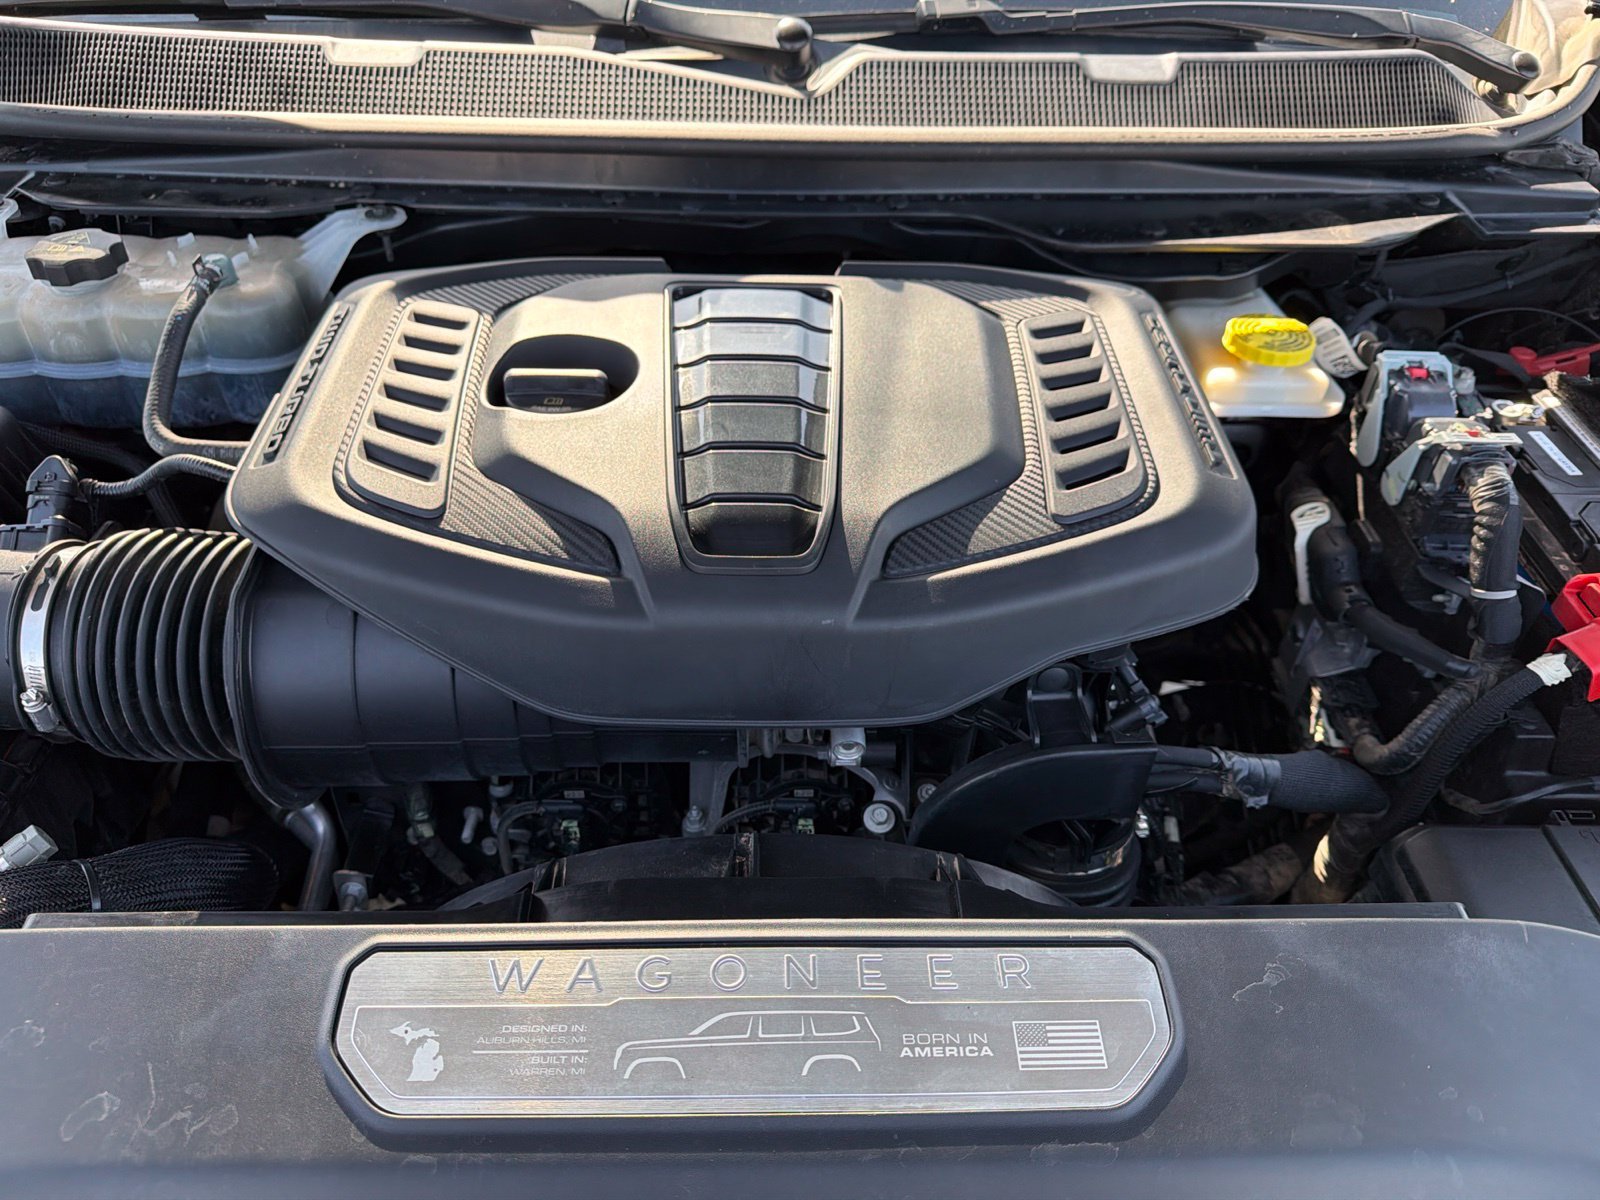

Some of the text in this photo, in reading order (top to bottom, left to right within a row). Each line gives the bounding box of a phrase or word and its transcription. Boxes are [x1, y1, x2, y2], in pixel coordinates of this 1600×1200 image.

[266, 305, 351, 452] TWIN TURBO
[488, 953, 1032, 993] WAGONEER
[501, 1023, 588, 1033] DESIGNED IN:
[476, 1036, 586, 1045] AUBURN HILLS, MI
[902, 1032, 988, 1045] BORN IN
[899, 1045, 994, 1058] AMERICA
[531, 1055, 588, 1064] BUILT IN:
[508, 1067, 586, 1076] WARREN, MI
